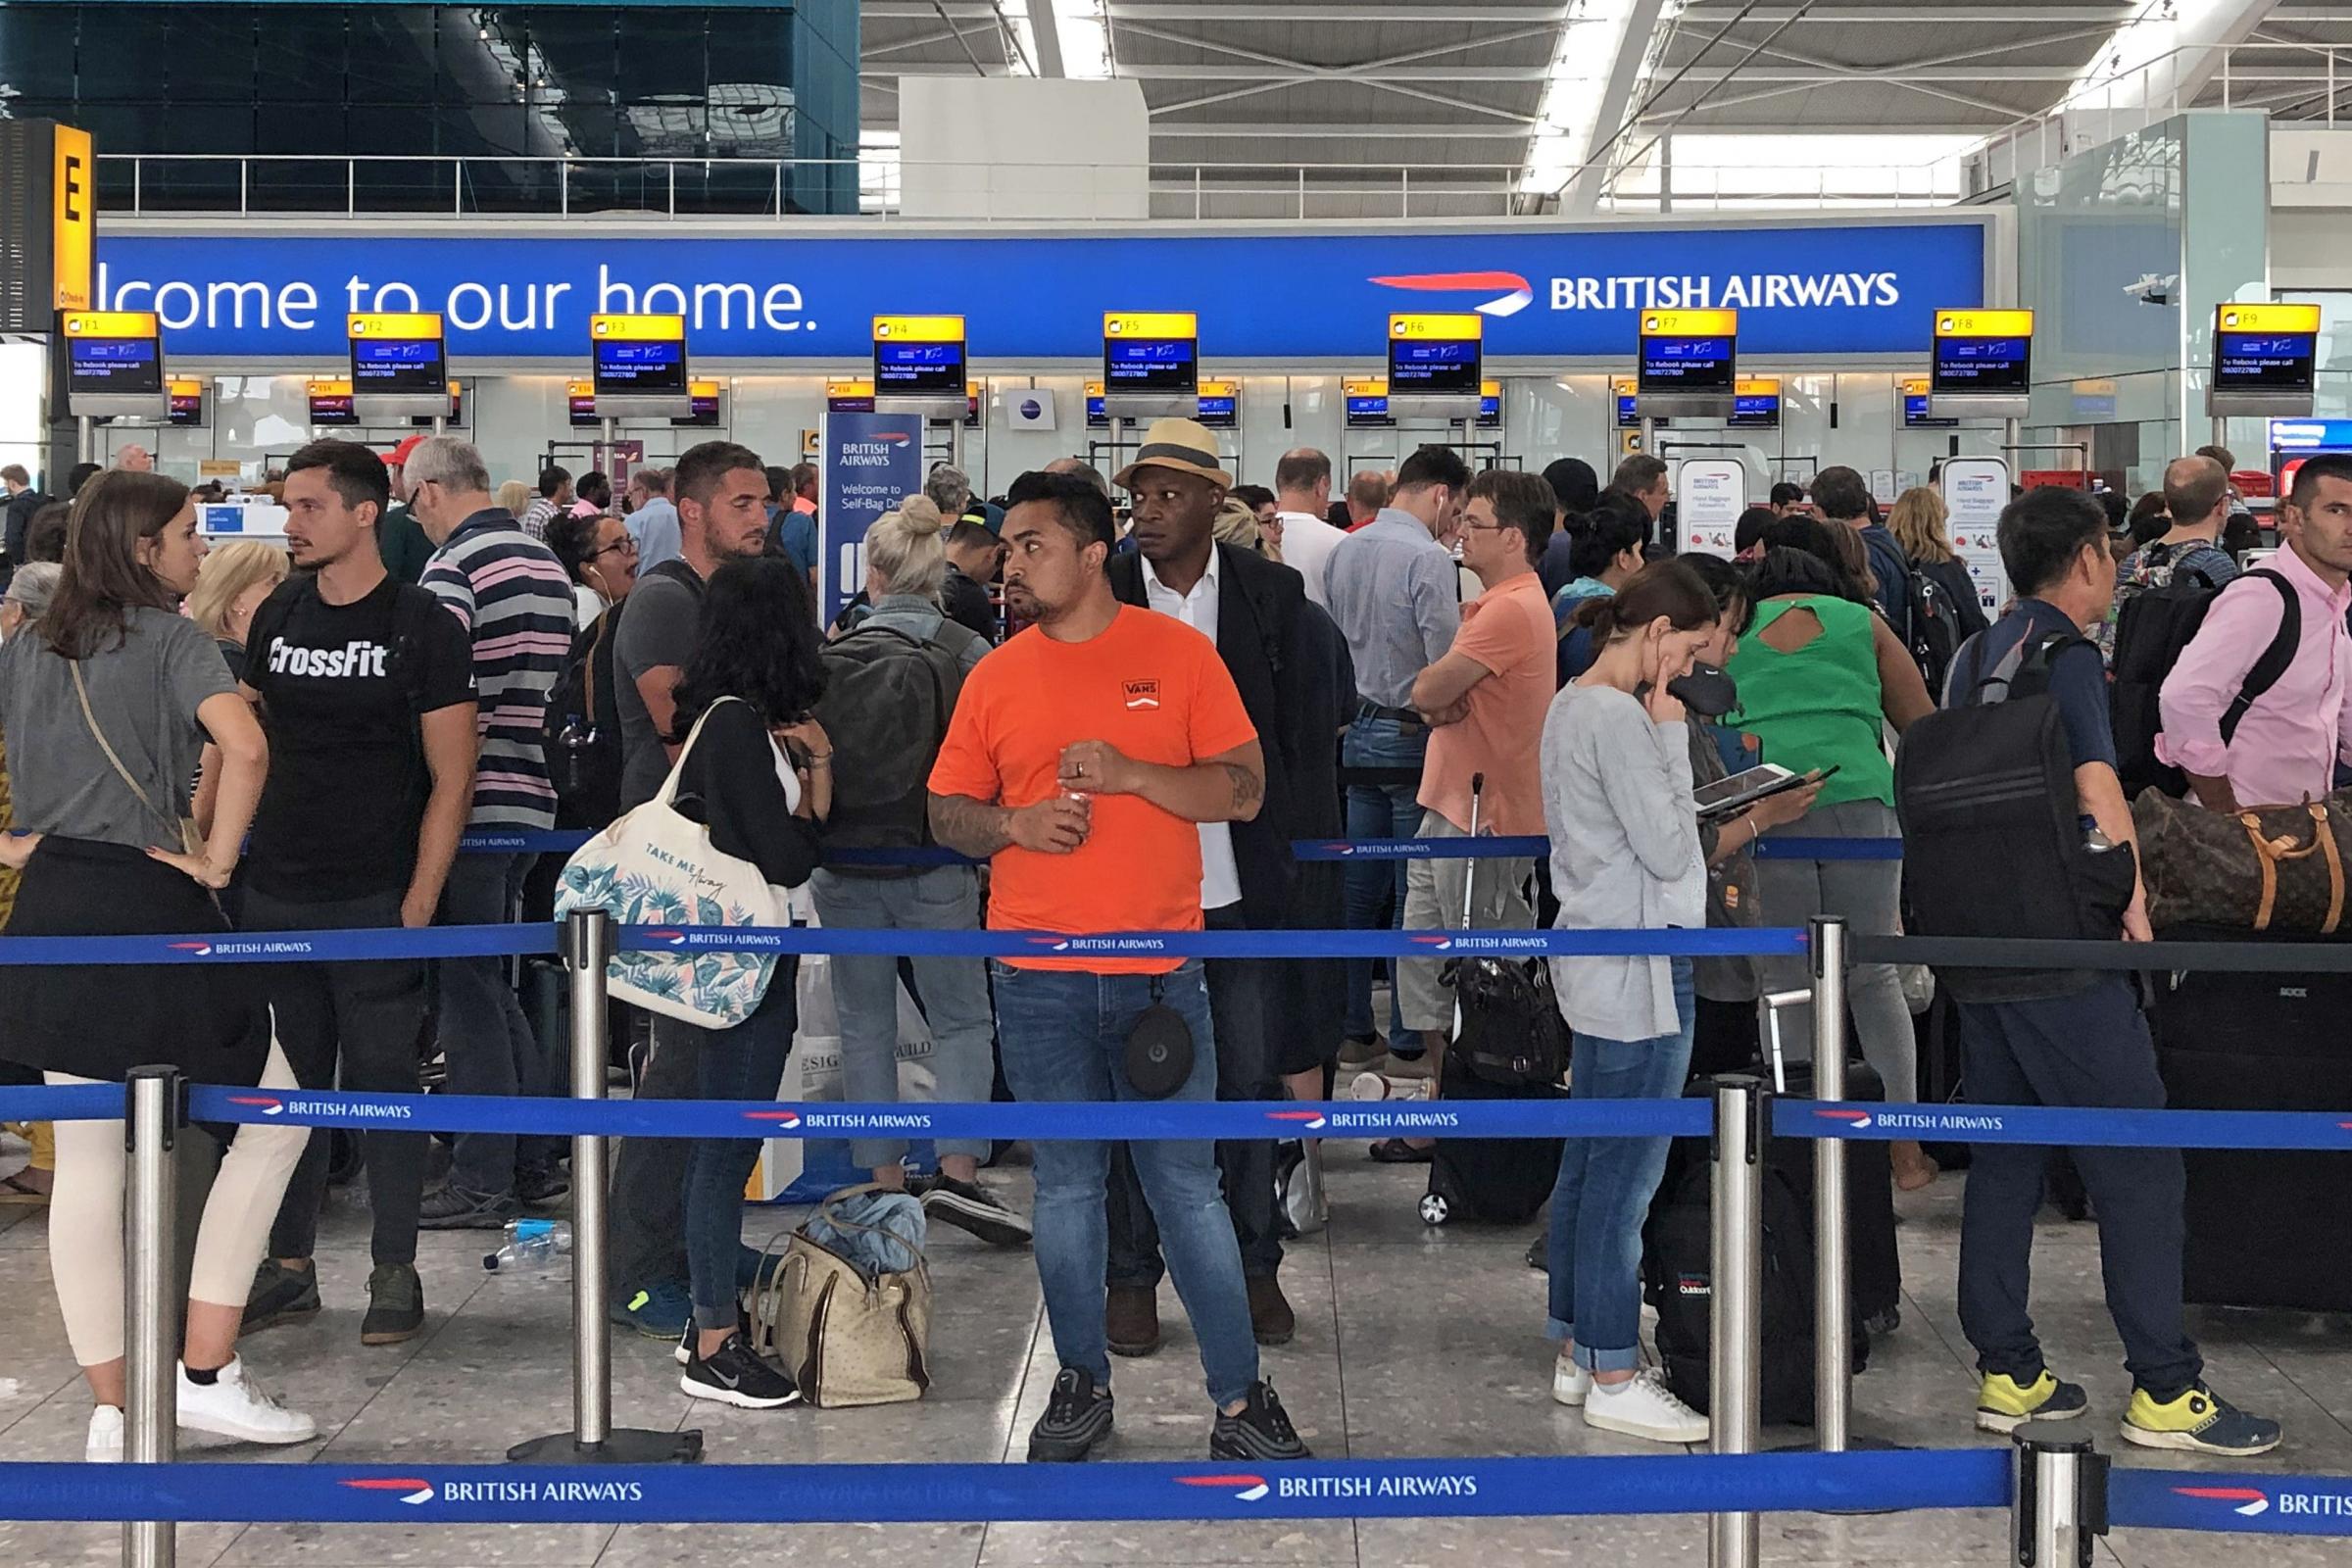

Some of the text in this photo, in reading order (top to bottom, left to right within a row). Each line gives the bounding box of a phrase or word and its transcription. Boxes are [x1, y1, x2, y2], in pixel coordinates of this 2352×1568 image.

[66, 156, 80, 222] E
[99, 262, 817, 330] lcome to our home.
[1550, 272, 1899, 310] BRITISH AIRWAYS
[1664, 318, 1677, 327] F7
[1959, 318, 1972, 328] F8
[2243, 314, 2258, 323] F9
[85, 320, 98, 330] F1
[369, 321, 381, 331] F2
[612, 323, 625, 332] F3
[895, 324, 907, 334] F4
[1126, 320, 1139, 330] F5
[1411, 321, 1424, 331] F6
[842, 443, 889, 454] BRITISH
[839, 455, 891, 466] AIRWAYS
[842, 483, 902, 495] Welcome to
[842, 498, 884, 512] Self-Bag
[268, 636, 387, 676] CrossFit
[1125, 681, 1156, 694] VANS
[488, 838, 526, 847] AIRWAYS
[1393, 844, 1431, 853] AIRWAYS
[647, 842, 696, 873] TAKE ME
[689, 933, 781, 946] BRITISH AIRWAYS
[1072, 939, 1164, 949] BRITISH AIRWAYS
[1455, 938, 1547, 948] BRITISH AIRWAYS
[217, 942, 312, 954] BRITISH AIRWAYS
[802, 1041, 932, 1072] ESIG UILD
[289, 1102, 412, 1118] BRITISH AIRWAYS
[807, 1114, 931, 1128] BRITISH AIRWAYS
[1333, 1113, 1458, 1127] BRITISH AIRWAYS
[1878, 1113, 2003, 1130] BRITISH AIRWAYS
[444, 1482, 643, 1501] BRITISH AIRWAYS
[1279, 1475, 1478, 1497] BRITISH AIRWAYS
[2279, 1494, 2352, 1516] BRITIS
